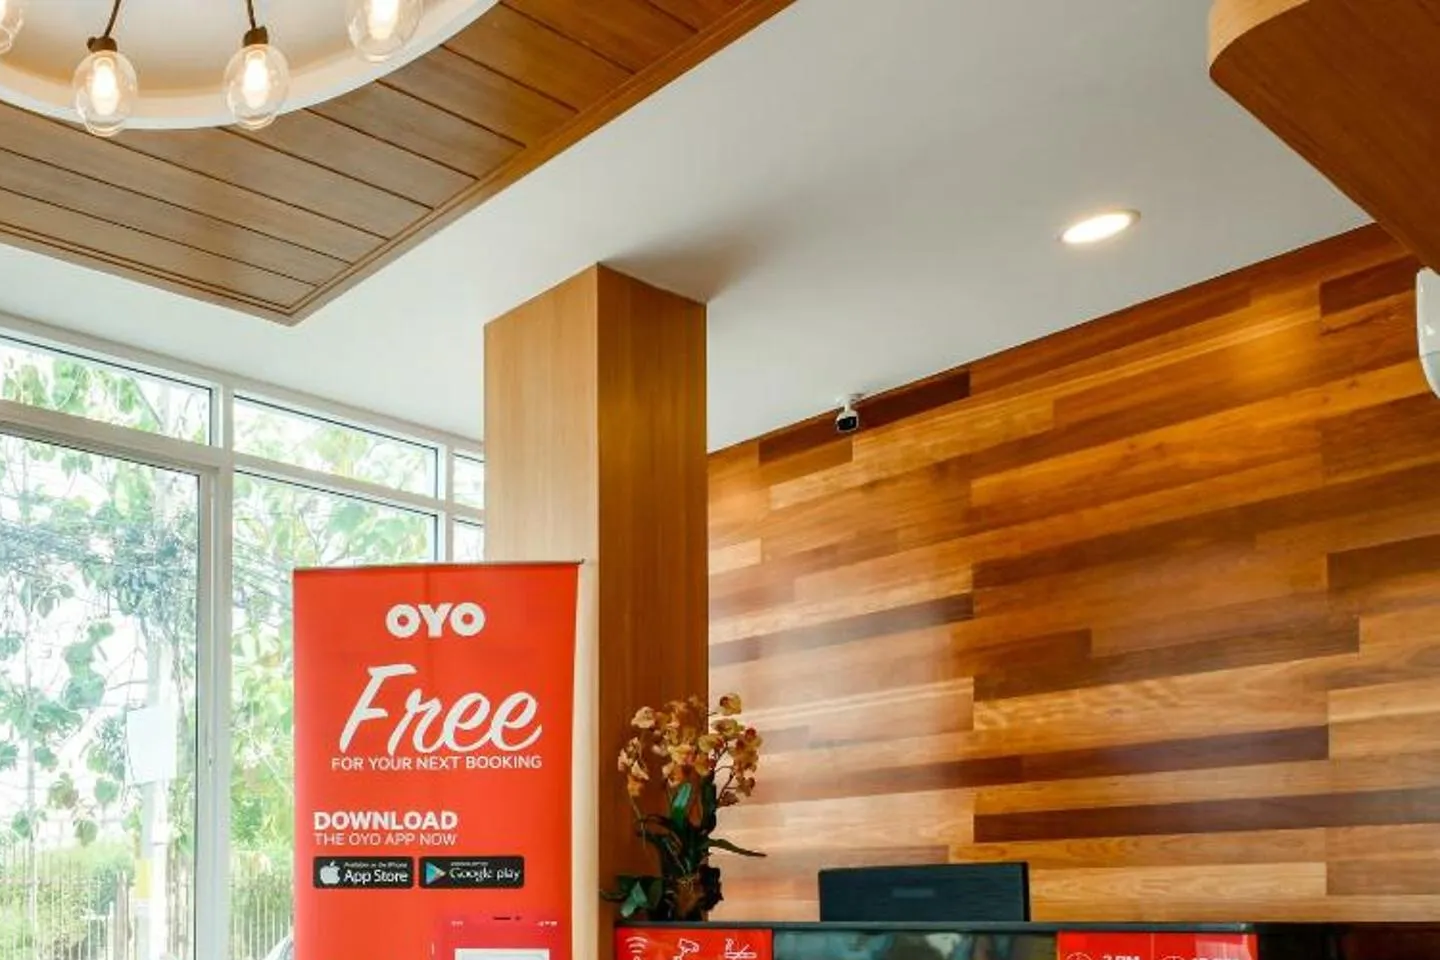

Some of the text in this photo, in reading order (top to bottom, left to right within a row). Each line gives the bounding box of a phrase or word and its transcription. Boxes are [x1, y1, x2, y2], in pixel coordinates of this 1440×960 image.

[385, 602, 486, 639] OYO
[338, 663, 543, 756] Free
[331, 755, 543, 771] FOR YOUR NEXT BOOKING
[313, 811, 459, 831] DOWNLOAD
[313, 833, 458, 846] THE OYO APP NOW
[343, 868, 409, 885] App Store
[449, 866, 521, 883] Google play
